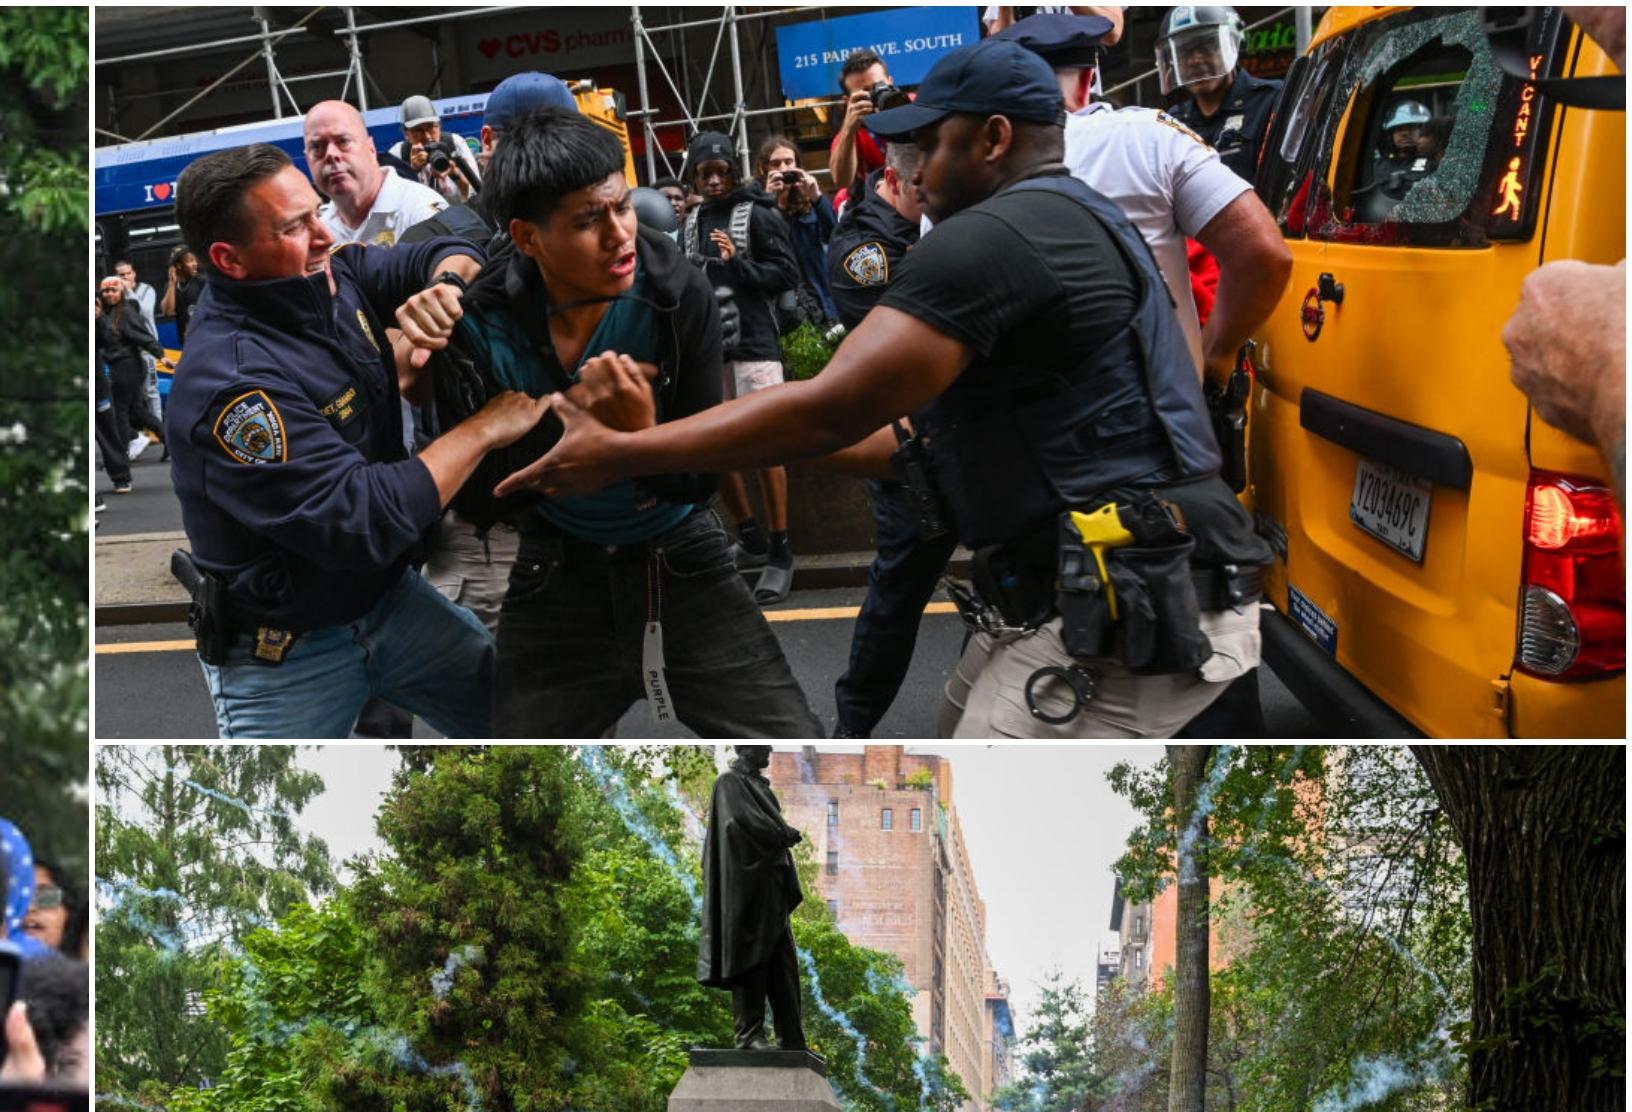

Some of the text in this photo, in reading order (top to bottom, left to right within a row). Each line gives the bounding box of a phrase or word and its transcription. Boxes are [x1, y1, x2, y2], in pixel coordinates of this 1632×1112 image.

[505, 29, 561, 58] CVS
[794, 54, 818, 68] 215
[904, 33, 963, 54] SOUTH
[648, 670, 671, 721] PURPLE
